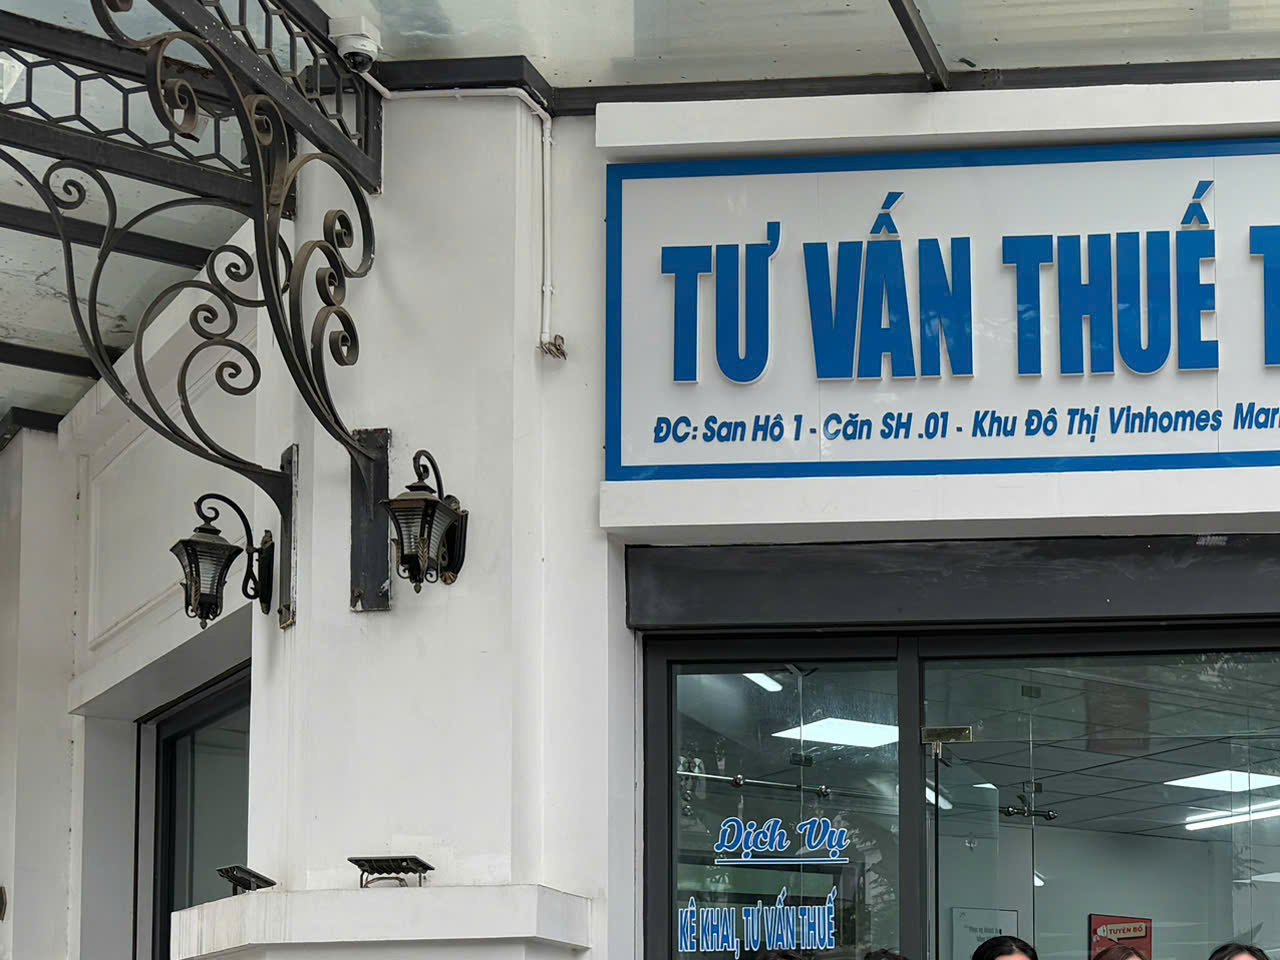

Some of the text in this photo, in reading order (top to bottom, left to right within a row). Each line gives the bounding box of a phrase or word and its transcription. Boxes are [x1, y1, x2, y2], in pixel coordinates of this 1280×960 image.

[661, 221, 780, 384] TƯ
[803, 192, 975, 380] VẤN
[1002, 180, 1220, 377] THUẾ
[653, 416, 698, 443] ĐC:
[702, 415, 747, 443] San
[750, 413, 785, 442] Hô
[793, 414, 803, 441] 1
[822, 413, 872, 441] Căn
[879, 411, 913, 440] SH
[971, 409, 1017, 438] Khu
[1024, 409, 1058, 437] Đô
[1066, 405, 1101, 443] Thị
[1108, 404, 1223, 435] Vinhomes
[714, 816, 851, 861] Dịch Vụ
[678, 886, 837, 960] KÊ KHAI, TƯ VẤN THUẾ
